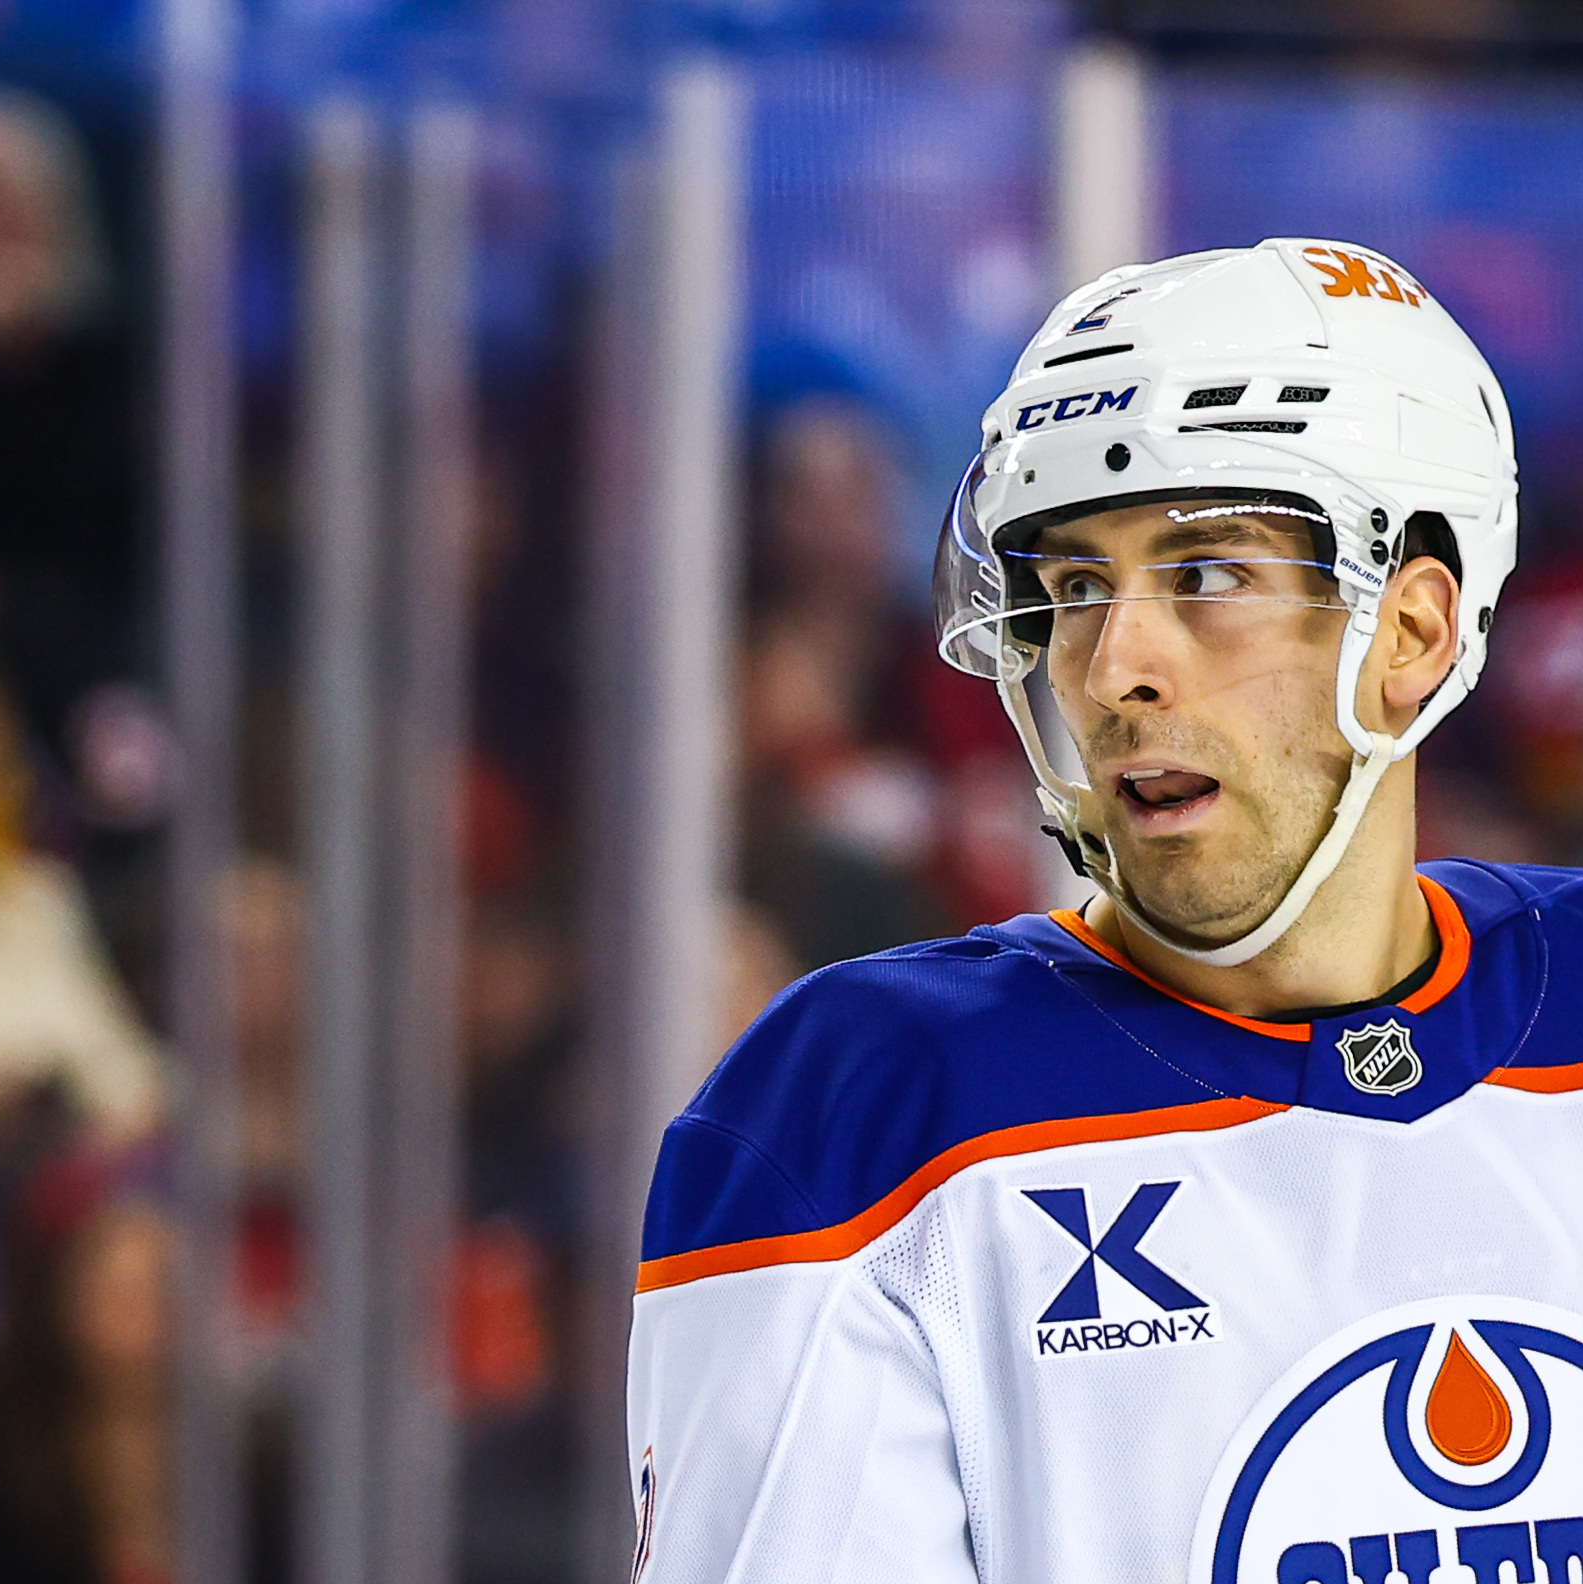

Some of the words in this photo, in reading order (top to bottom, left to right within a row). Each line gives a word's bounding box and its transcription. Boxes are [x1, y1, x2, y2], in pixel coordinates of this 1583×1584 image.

[1016, 385, 1139, 431] CCM
[1362, 1041, 1400, 1084] NHL
[1037, 1312, 1215, 1355] KARBON-X
